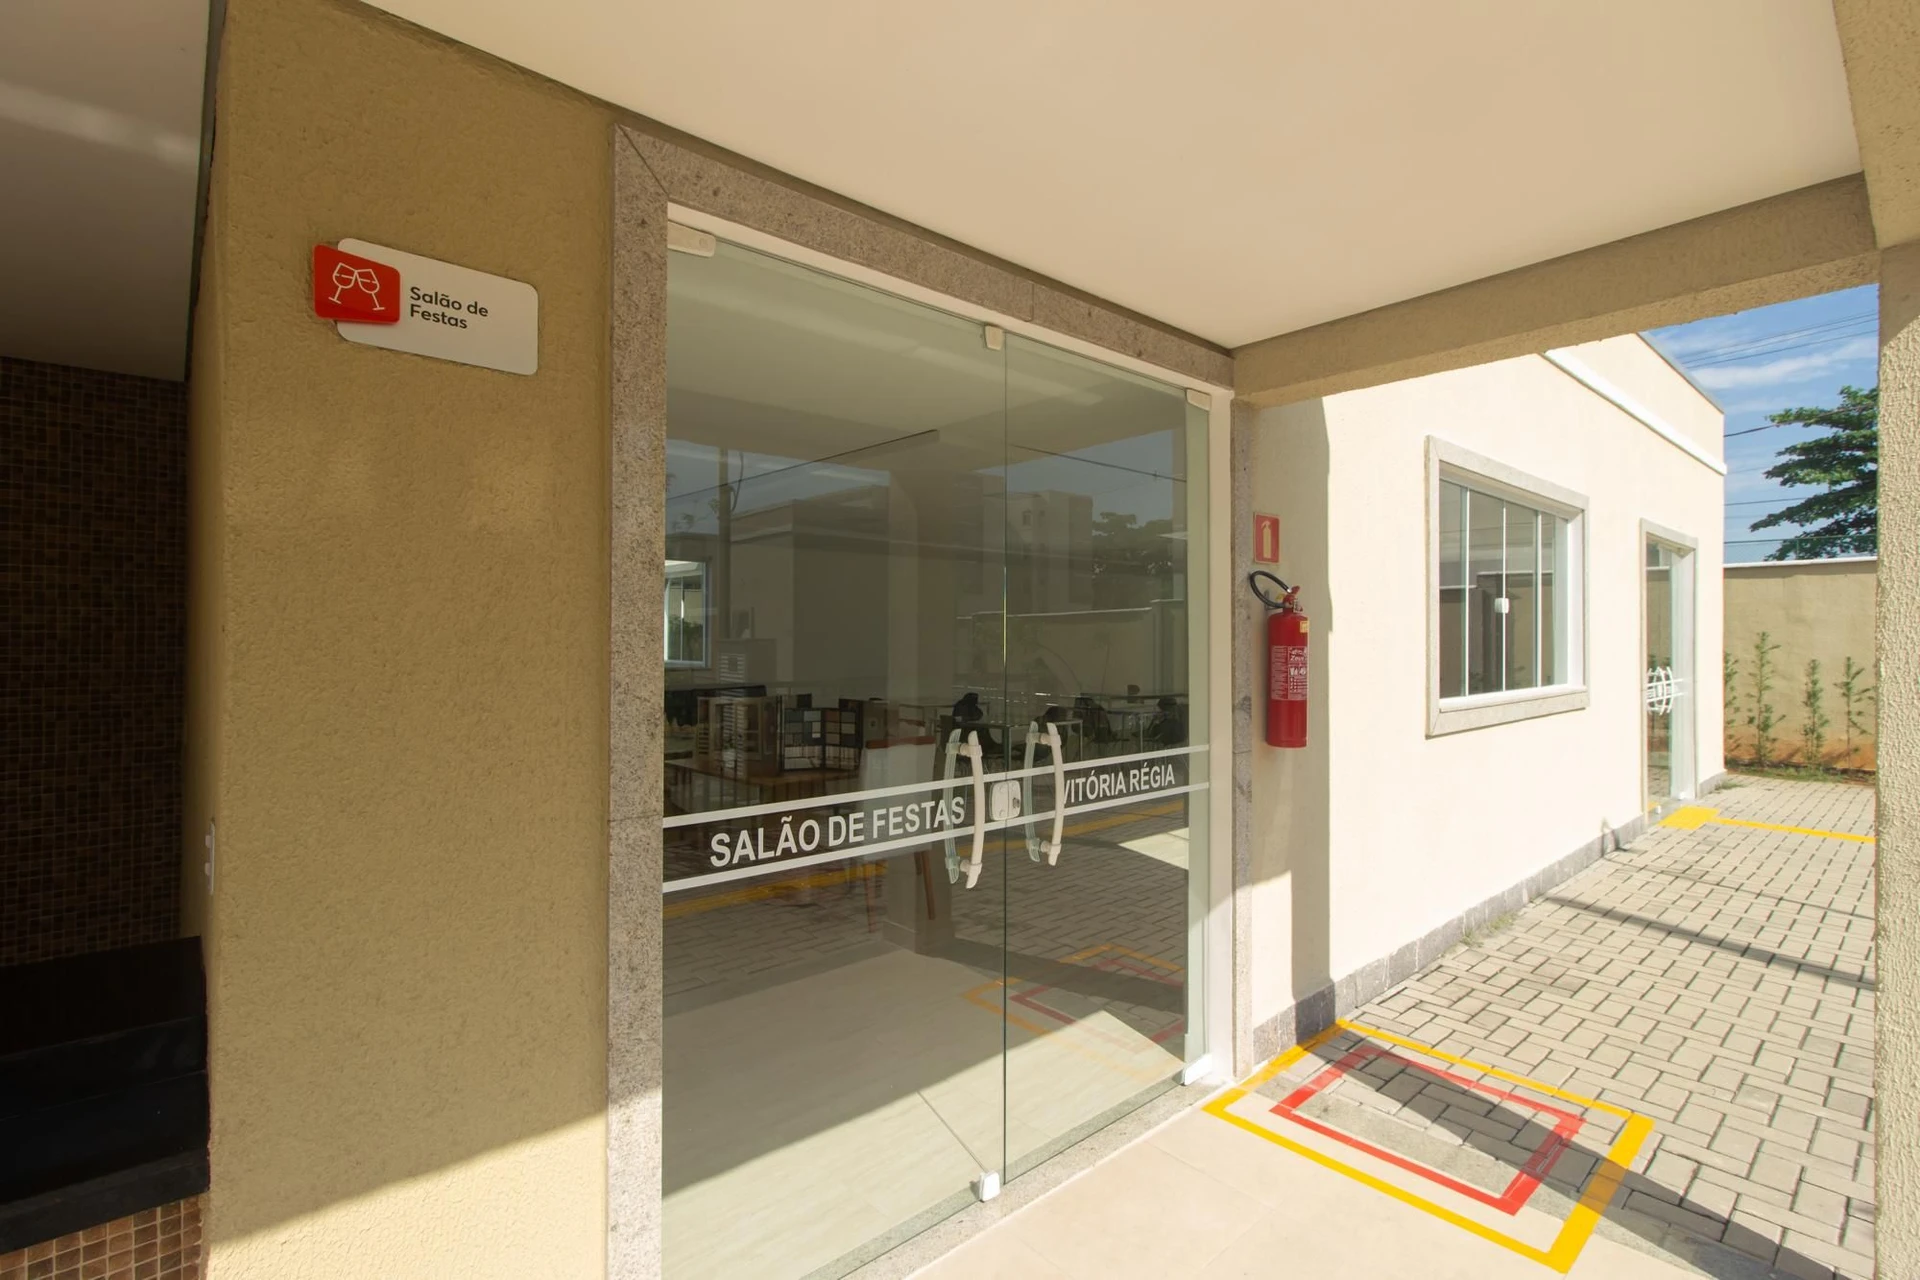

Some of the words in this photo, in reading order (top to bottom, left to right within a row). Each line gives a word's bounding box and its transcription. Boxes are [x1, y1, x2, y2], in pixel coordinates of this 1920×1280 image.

[410, 286, 462, 311] Salão
[467, 301, 489, 317] de
[410, 303, 468, 329] Festas
[1129, 762, 1176, 793] RÉGIA
[710, 815, 821, 868] SALÃO
[828, 813, 865, 847] DE
[872, 796, 966, 839] FESTAS
